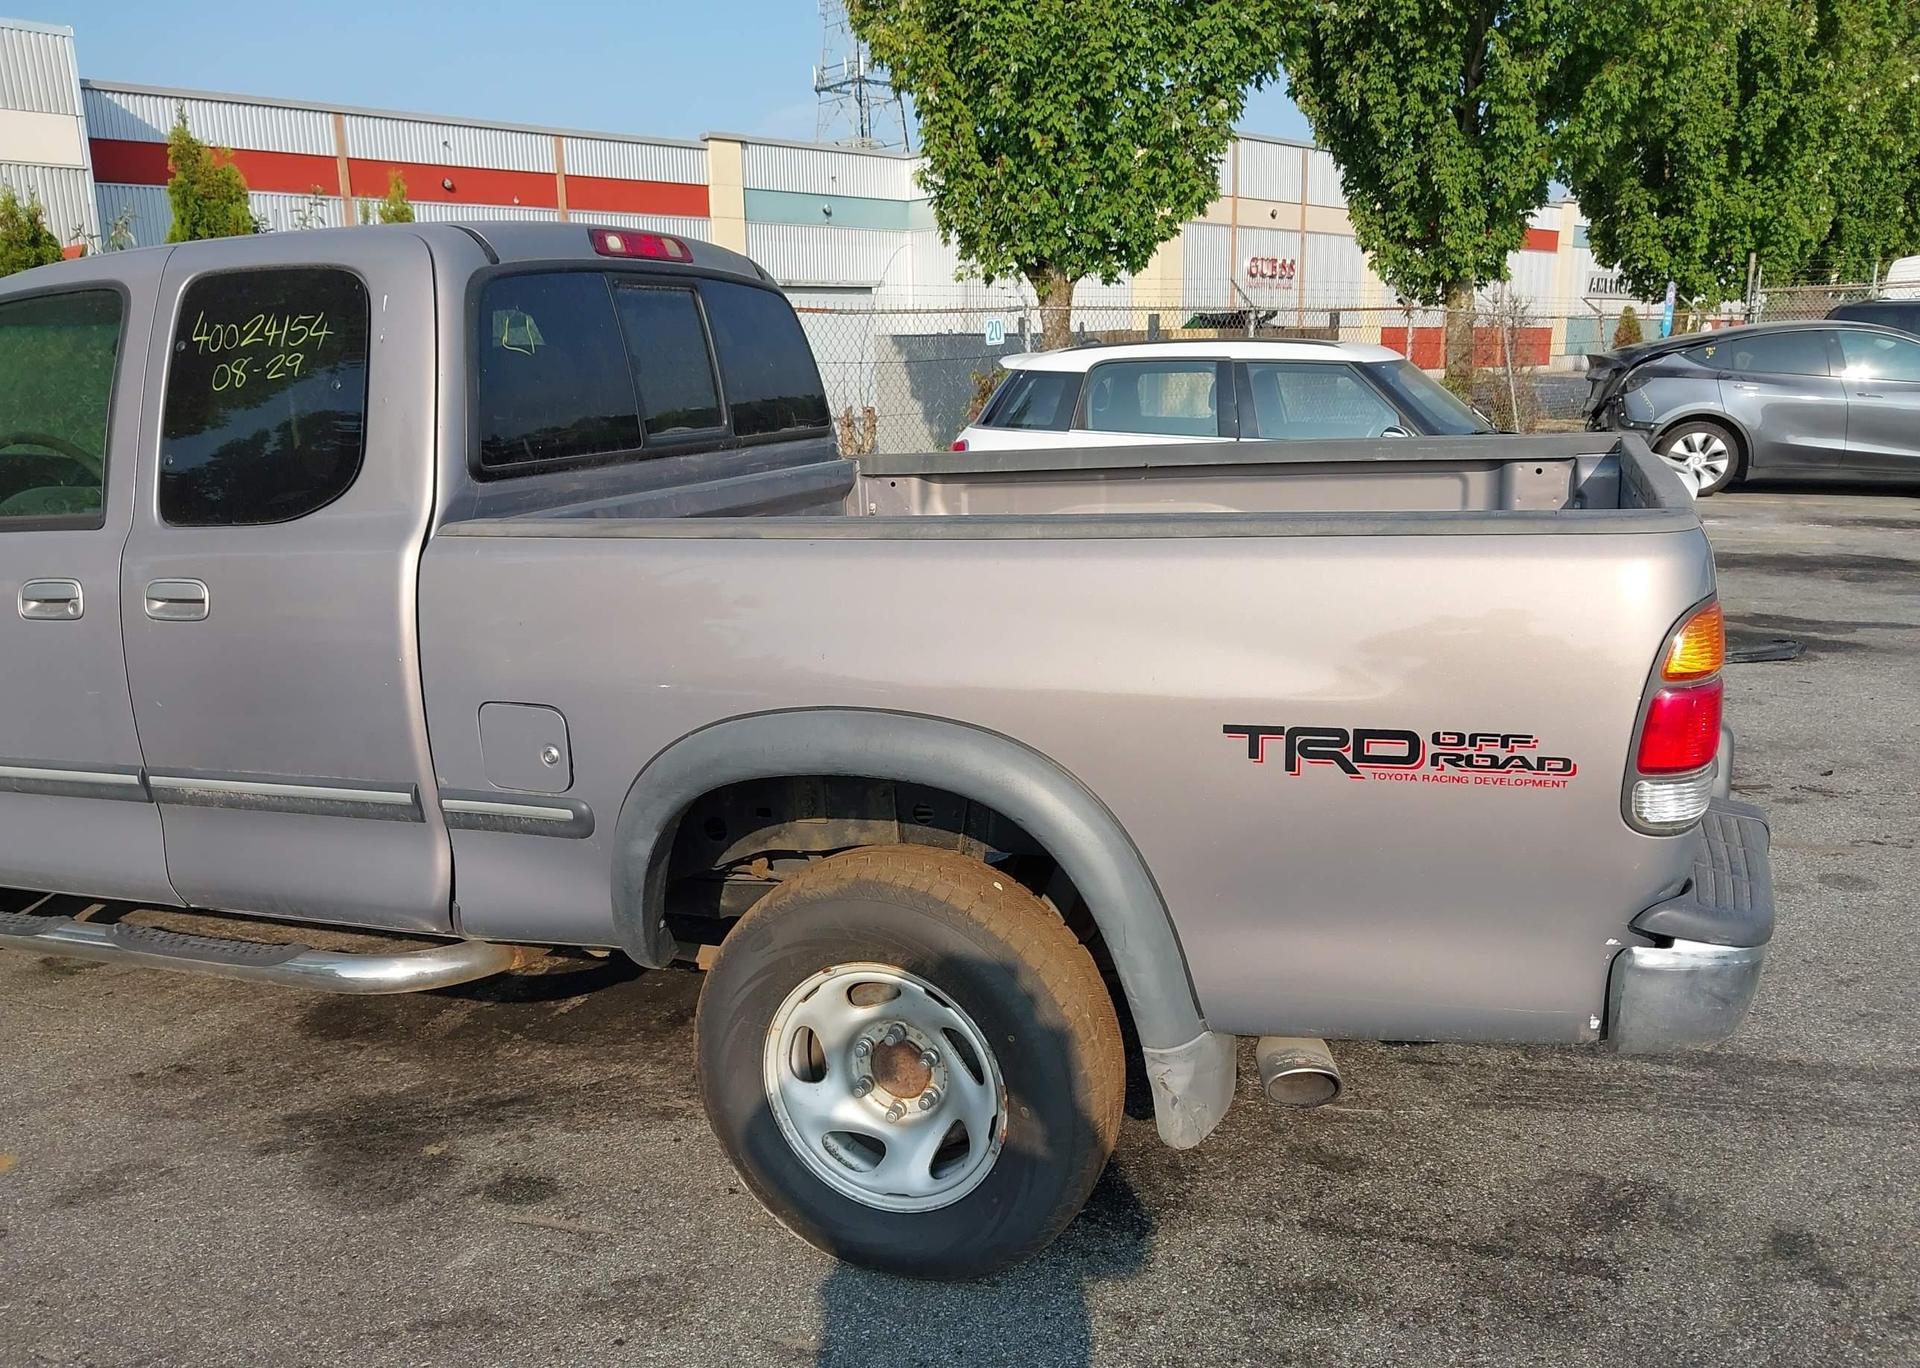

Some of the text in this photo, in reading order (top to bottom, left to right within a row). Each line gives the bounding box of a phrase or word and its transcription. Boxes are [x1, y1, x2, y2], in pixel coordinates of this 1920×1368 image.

[1249, 257, 1296, 280] GUESS
[192, 310, 335, 355] 40024154
[987, 320, 1002, 341] 20
[1222, 724, 1426, 779] TRD
[1431, 731, 1539, 753] OFF
[1430, 752, 1577, 777] ROAD
[1371, 771, 1569, 789] TOYOTA RACING DEVELOPMENT
